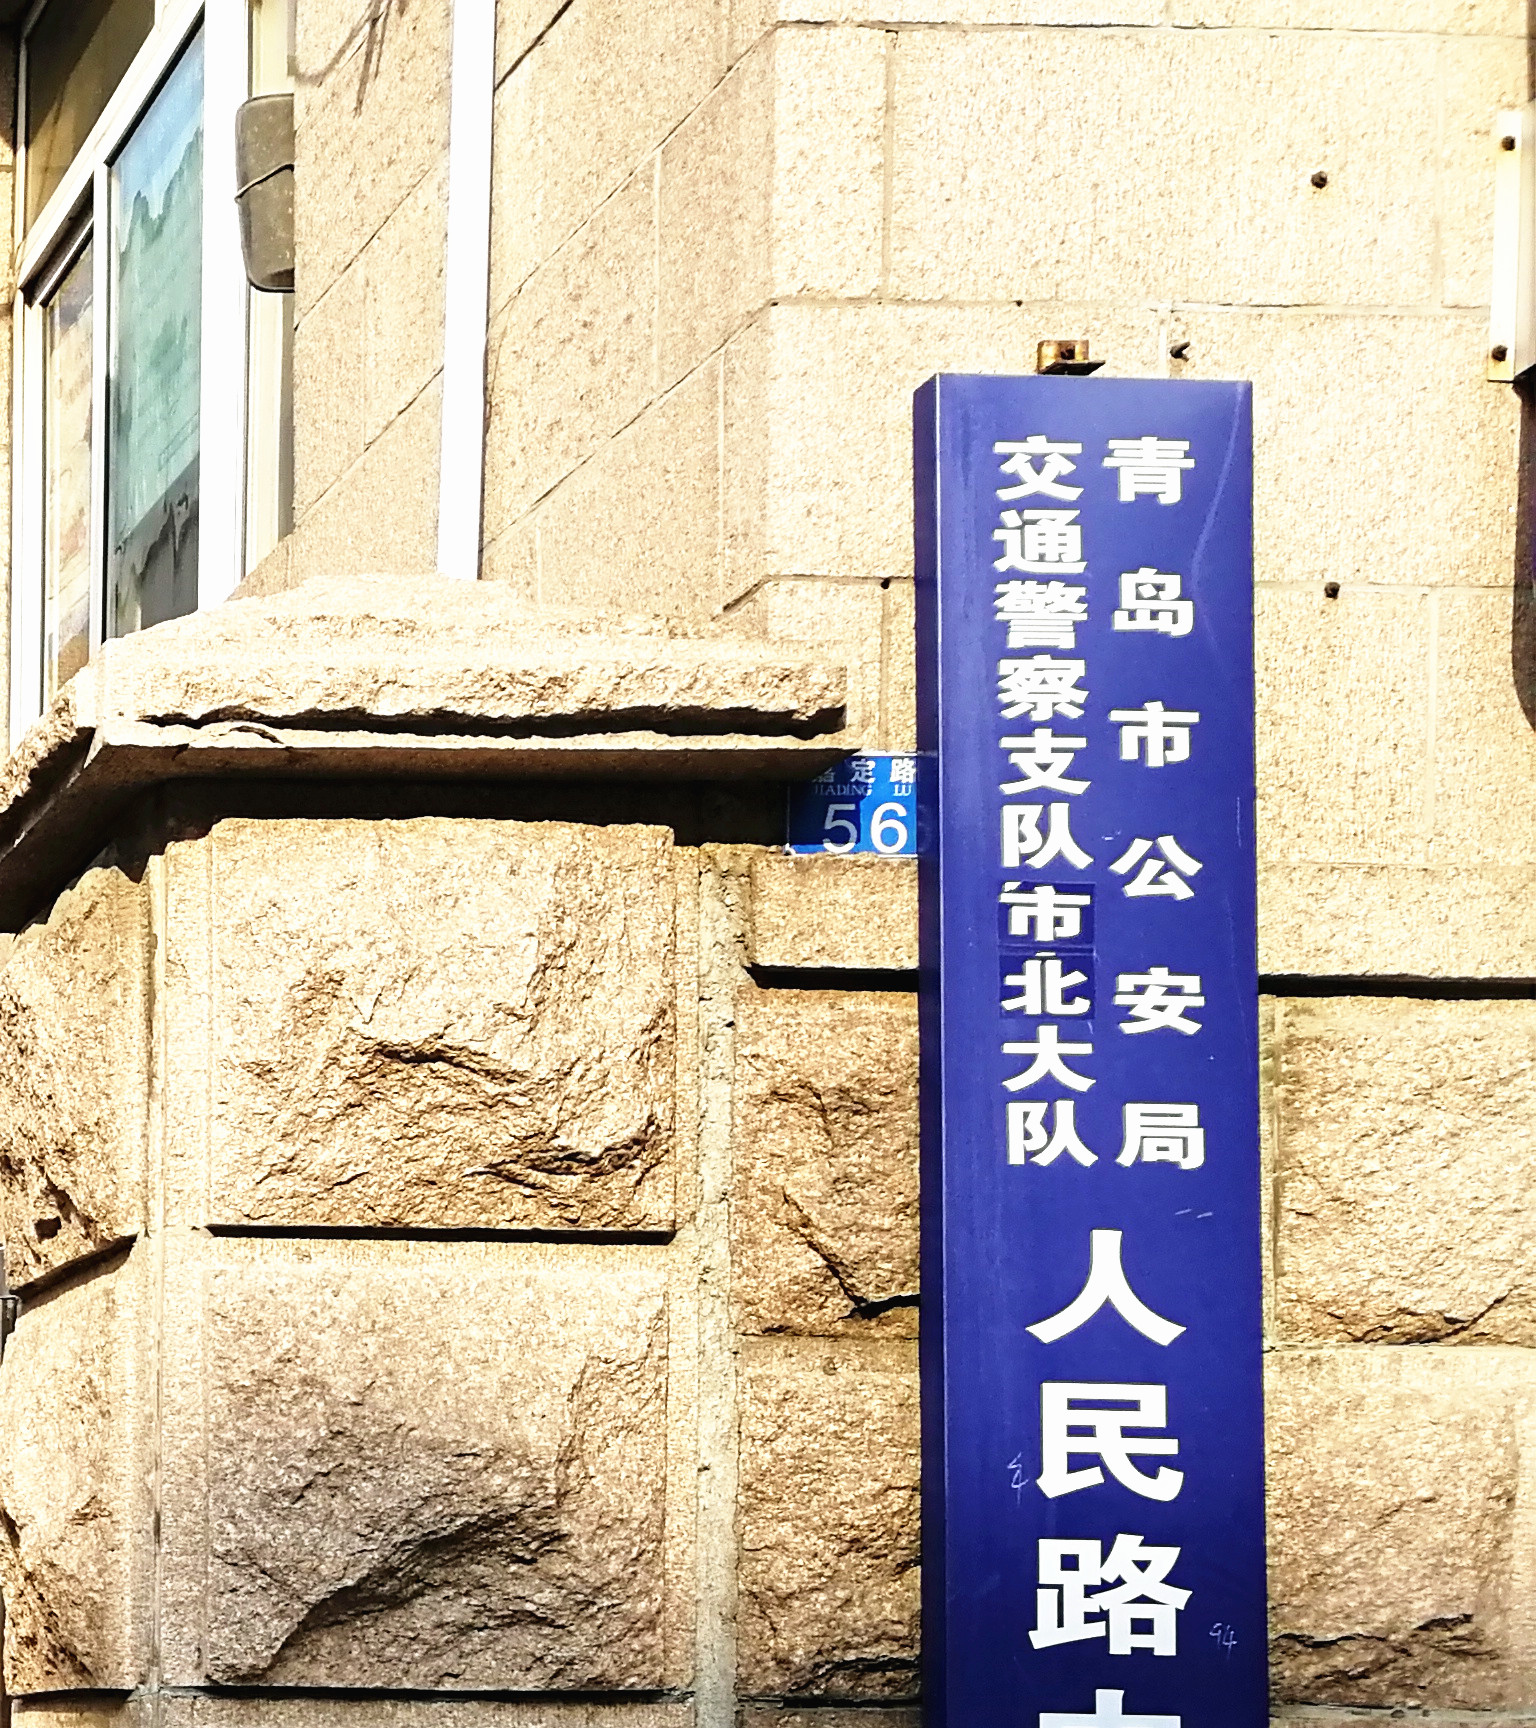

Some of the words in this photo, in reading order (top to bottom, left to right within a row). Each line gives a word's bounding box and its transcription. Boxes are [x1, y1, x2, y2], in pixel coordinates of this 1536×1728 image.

[822, 801, 909, 855] 56
[893, 784, 913, 797] LU
[991, 434, 1098, 1167] 交通警察支队市北大队
[1101, 436, 1207, 1169] 青岛市公安局
